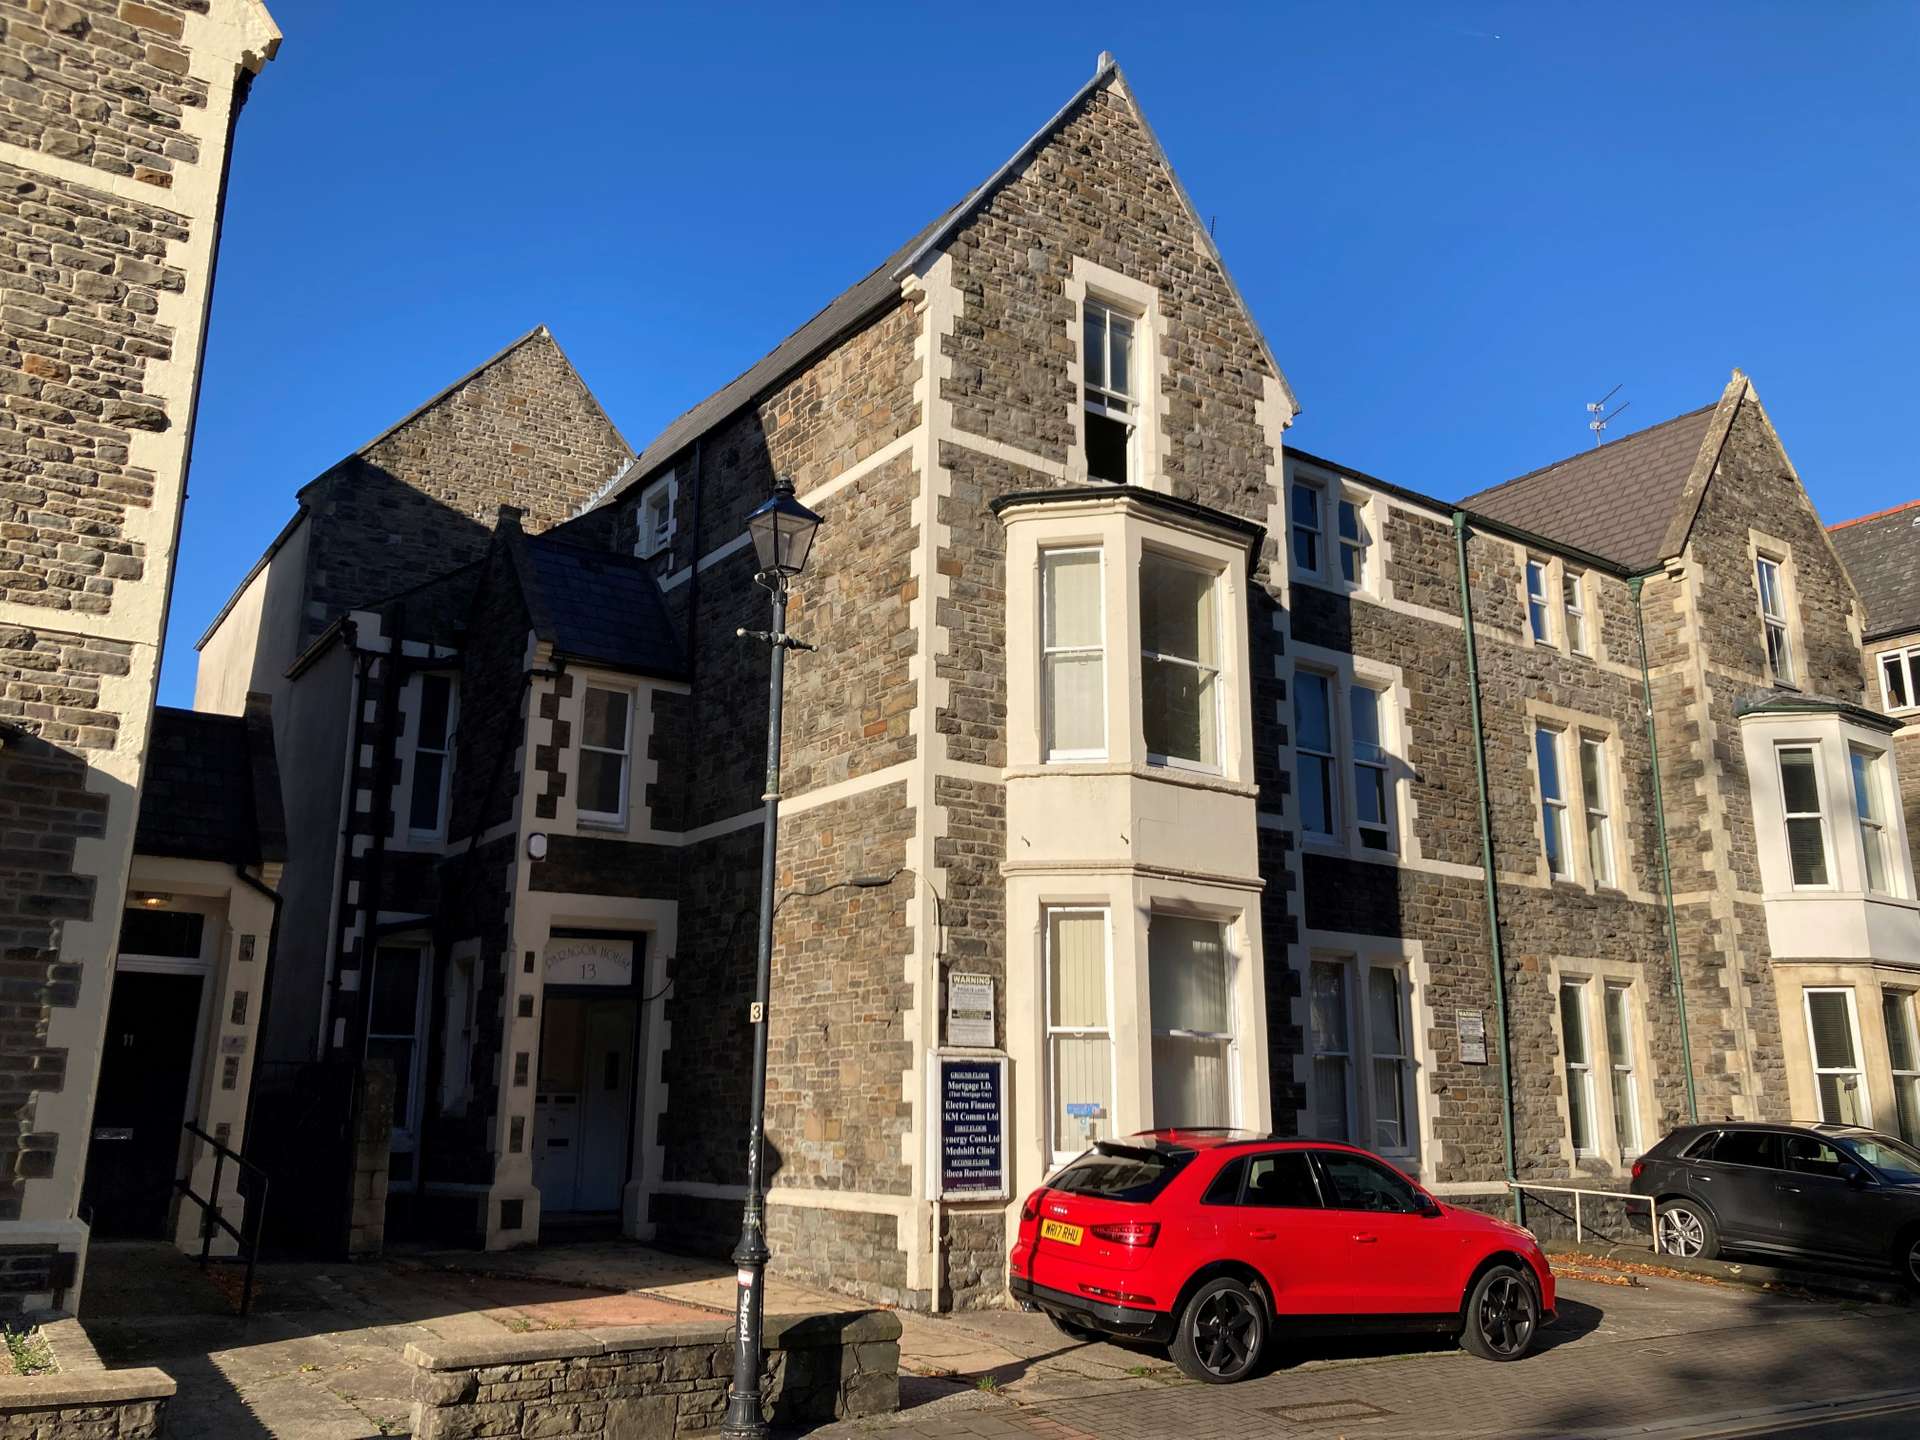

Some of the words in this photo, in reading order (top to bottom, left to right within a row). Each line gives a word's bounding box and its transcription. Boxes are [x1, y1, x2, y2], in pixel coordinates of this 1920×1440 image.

[582, 962, 597, 979] 13
[953, 975, 991, 986] WARNING
[753, 1004, 761, 1020] 3
[123, 1033, 134, 1047] 11
[943, 1135, 968, 1146] ynergy
